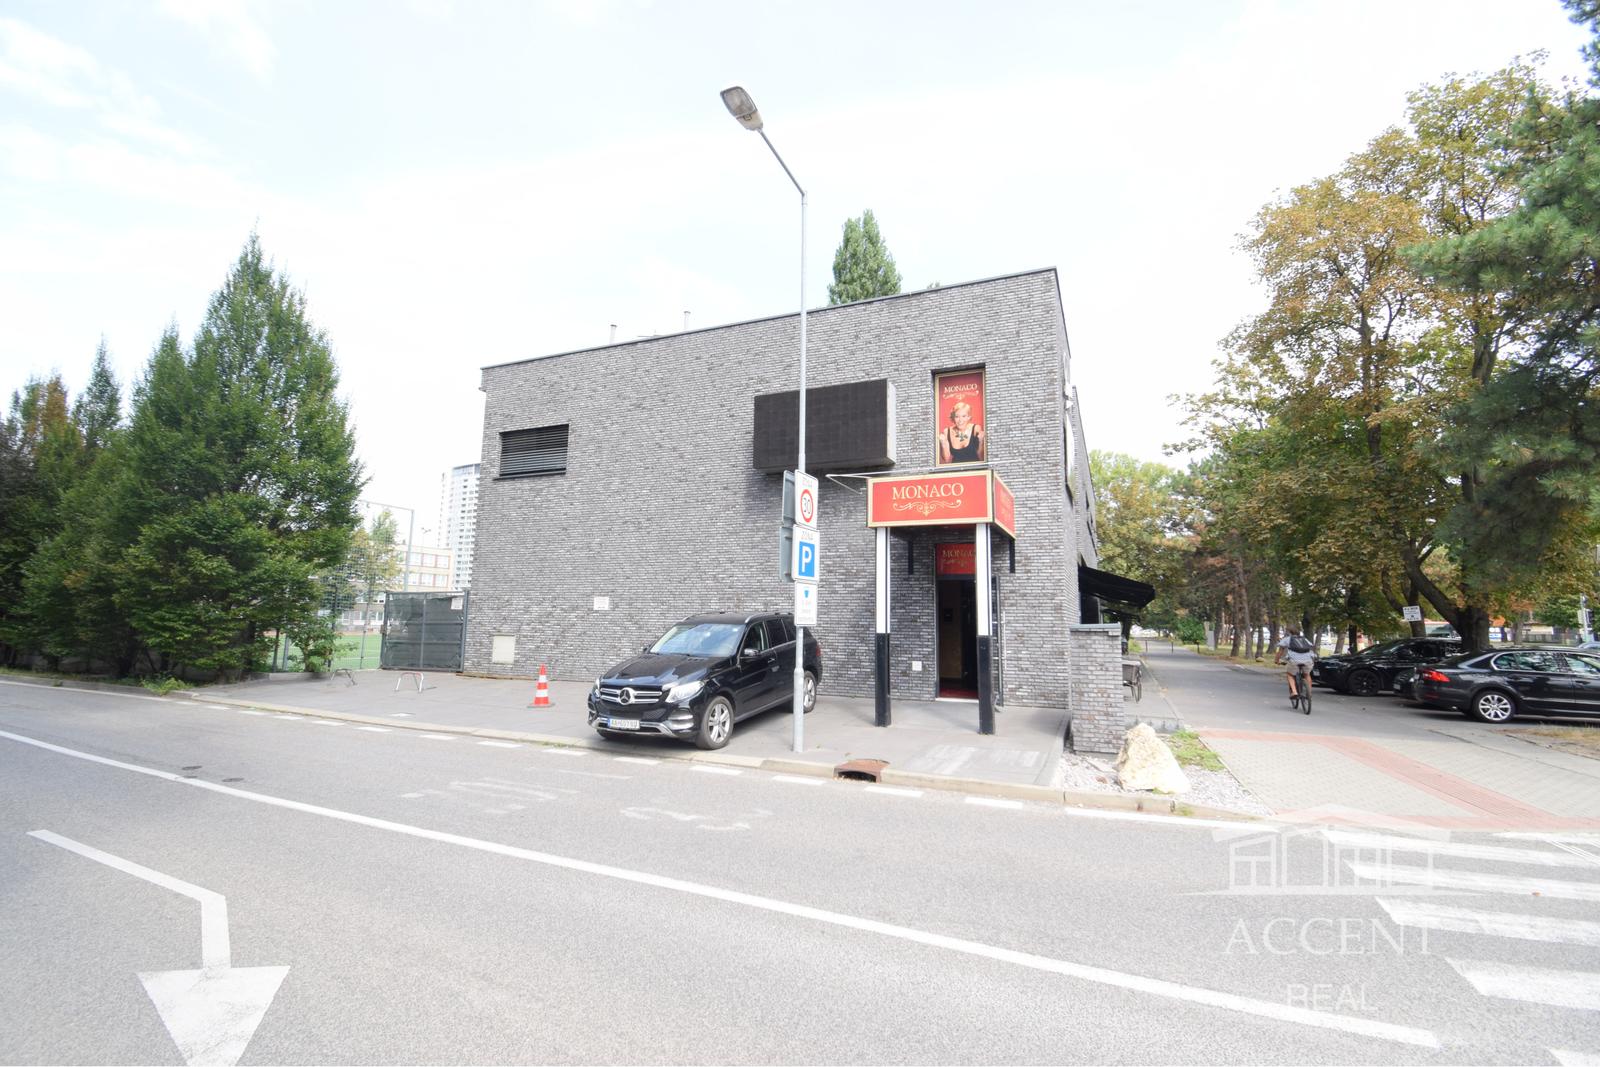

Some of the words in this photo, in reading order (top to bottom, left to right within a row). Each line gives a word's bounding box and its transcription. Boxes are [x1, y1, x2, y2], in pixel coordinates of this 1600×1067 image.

[944, 383, 978, 393] MONACO
[892, 483, 965, 500] MONACO
[803, 497, 812, 514] 30
[802, 545, 812, 573] P
